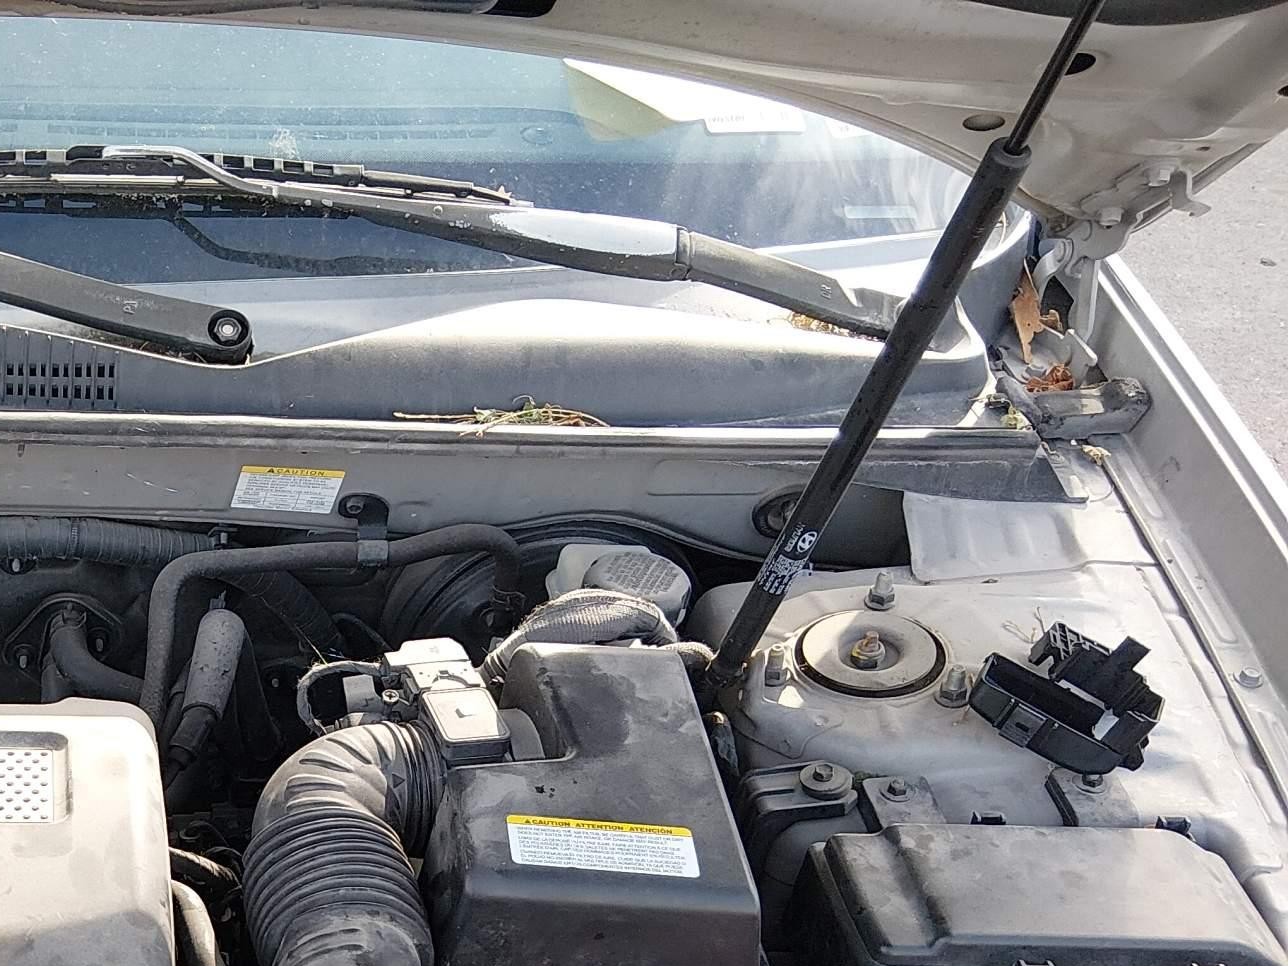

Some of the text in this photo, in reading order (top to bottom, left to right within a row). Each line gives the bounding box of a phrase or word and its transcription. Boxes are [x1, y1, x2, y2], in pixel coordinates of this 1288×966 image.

[276, 468, 325, 476] CAUTION
[532, 819, 571, 827] CAUTION
[575, 823, 624, 831] ATTENTION
